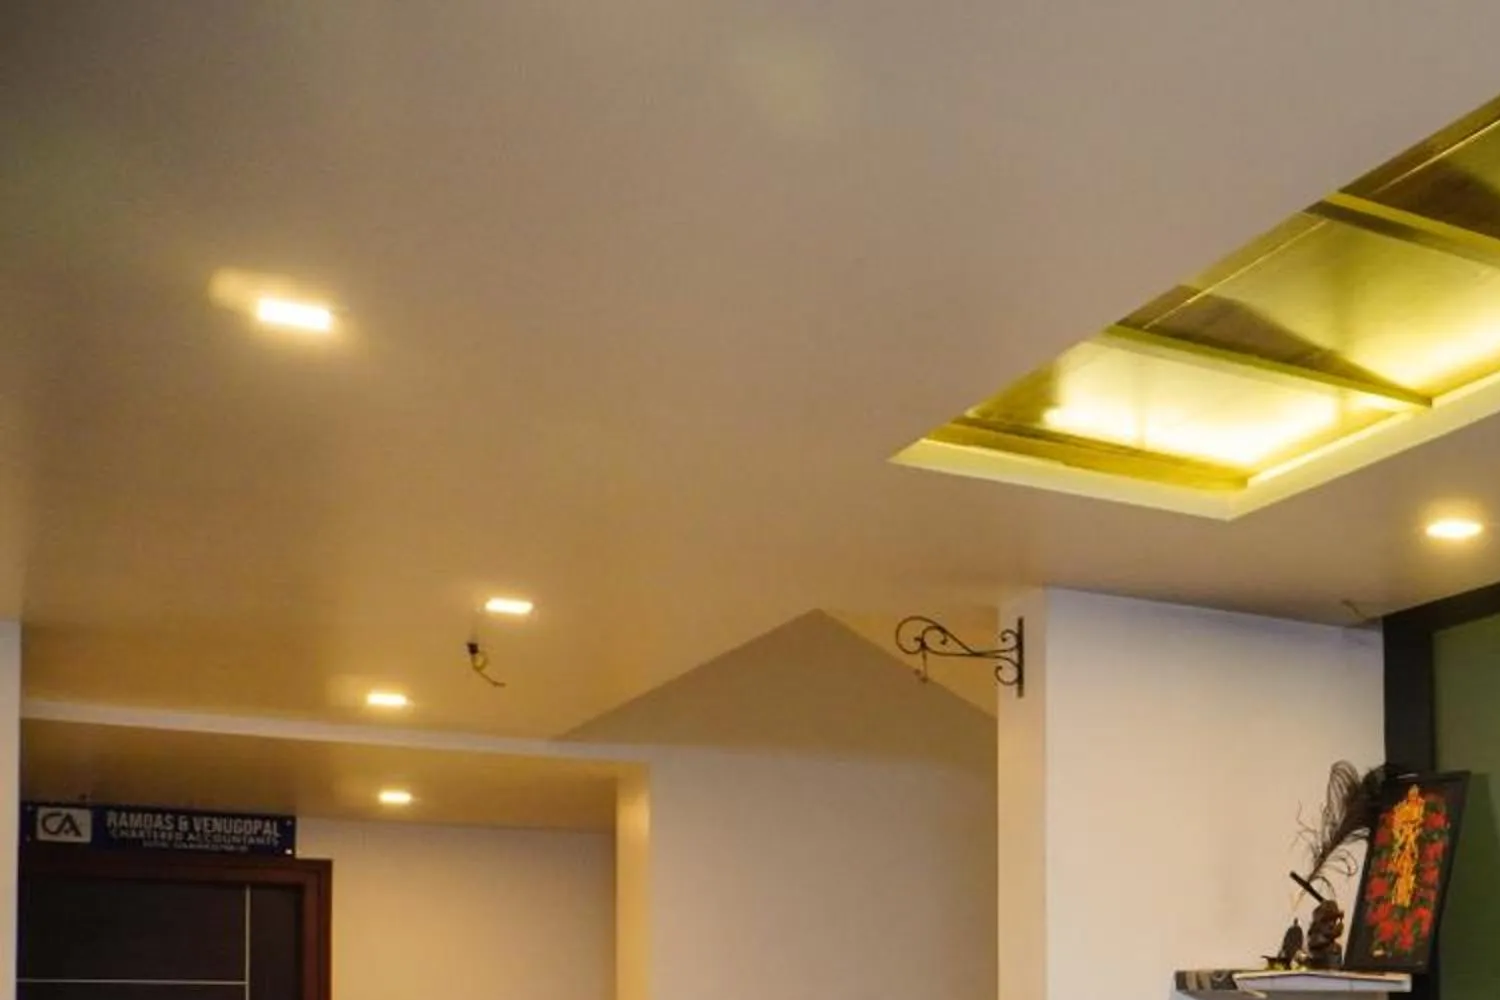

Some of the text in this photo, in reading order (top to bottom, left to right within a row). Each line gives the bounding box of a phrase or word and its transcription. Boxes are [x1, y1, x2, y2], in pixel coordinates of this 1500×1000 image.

[41, 812, 83, 837] CA
[106, 810, 281, 838] RAMDAS & VENUGOPAL
